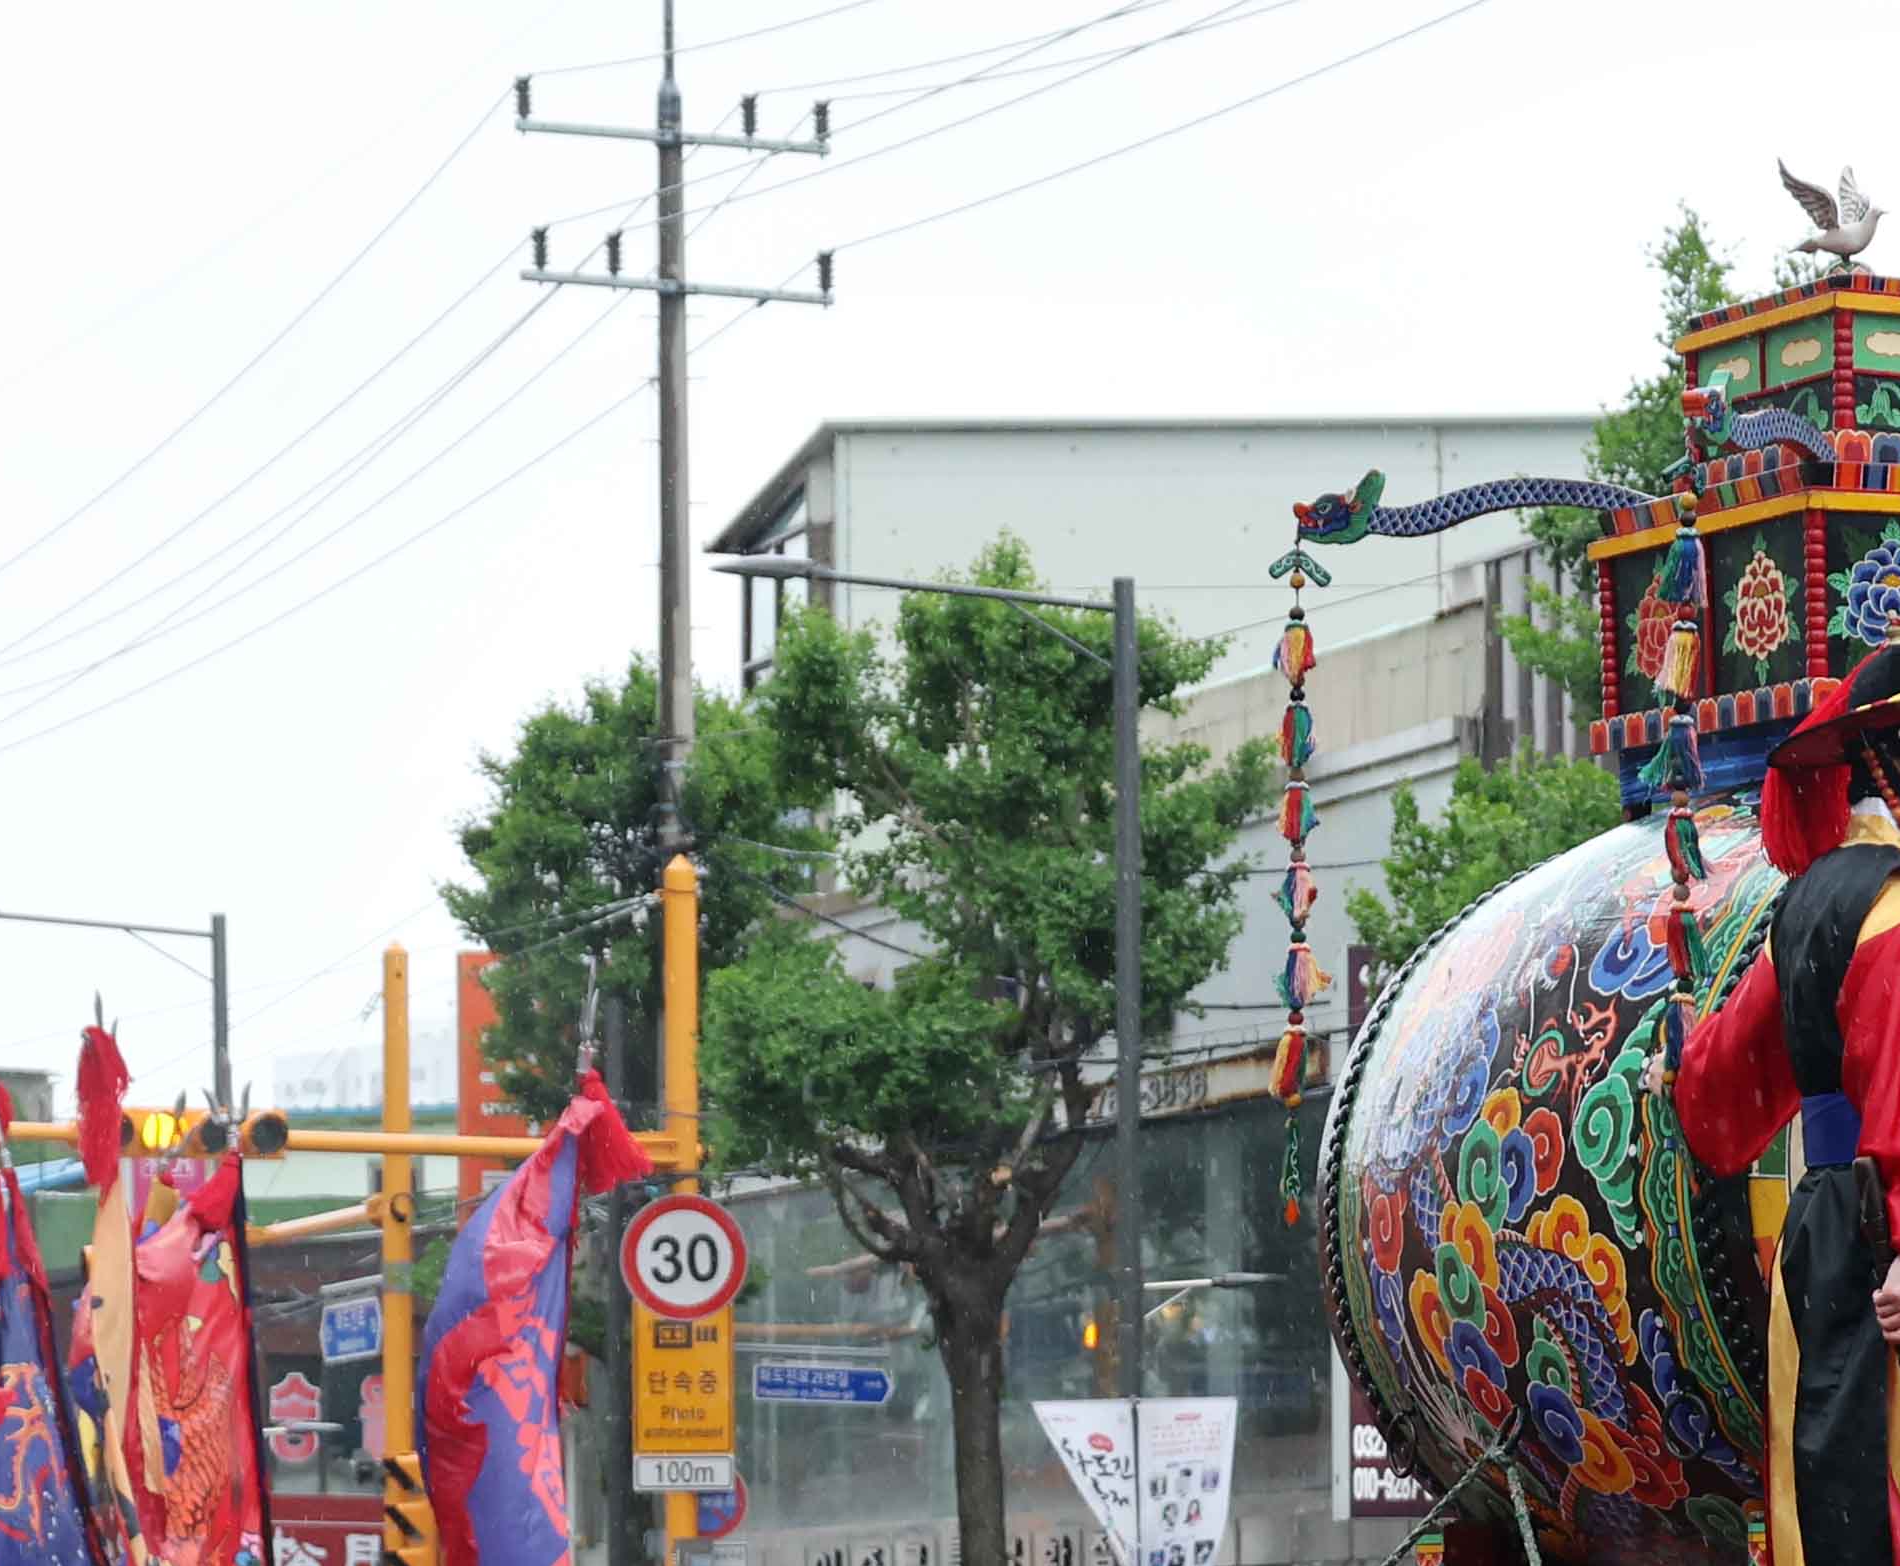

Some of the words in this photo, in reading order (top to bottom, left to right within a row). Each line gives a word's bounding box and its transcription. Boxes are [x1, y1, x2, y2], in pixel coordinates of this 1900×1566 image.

[651, 1234, 718, 1284] 30
[647, 1370, 717, 1395] 단속중
[660, 1404, 706, 1421] Photo
[655, 1461, 714, 1483] 100m
